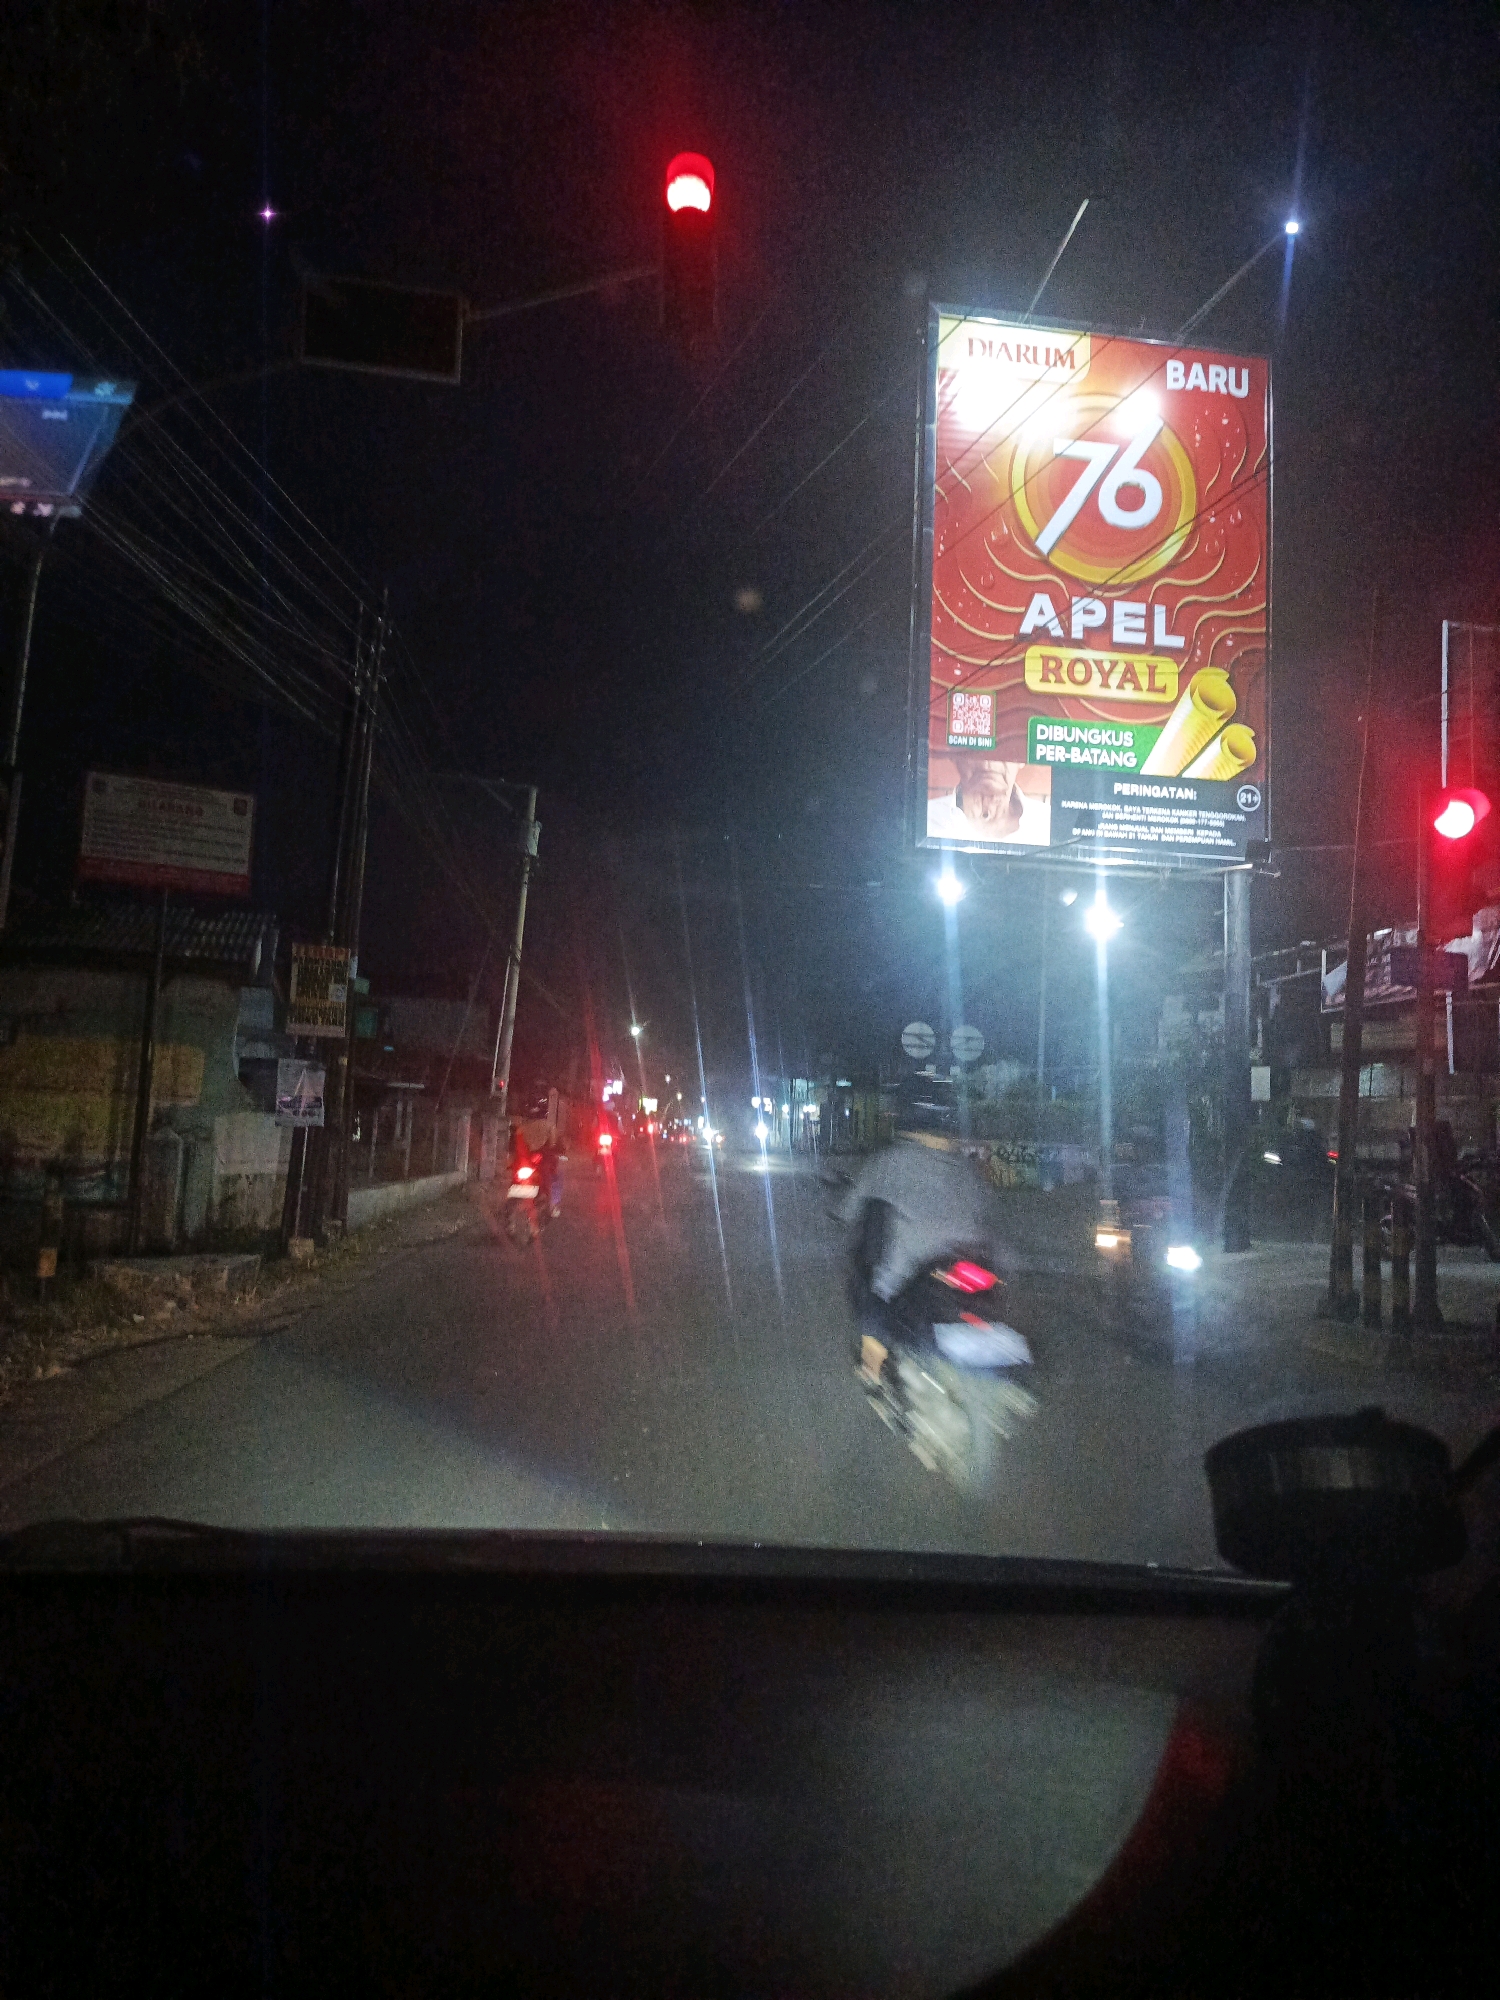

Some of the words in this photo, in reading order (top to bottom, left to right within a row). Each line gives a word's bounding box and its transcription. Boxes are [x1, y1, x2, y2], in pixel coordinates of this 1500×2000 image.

[1166, 359, 1249, 398] BARU
[1035, 412, 1164, 556] 76
[1019, 592, 1185, 649] APEL
[1039, 654, 1168, 695] ROYAL
[948, 735, 968, 745] SCAN
[968, 737, 977, 746] DI
[1036, 724, 1134, 746] DIBUNGKUS
[1035, 744, 1138, 768] PER-BATANG
[1113, 782, 1197, 802] PERINGATAN:
[1240, 792, 1259, 804] 21+
